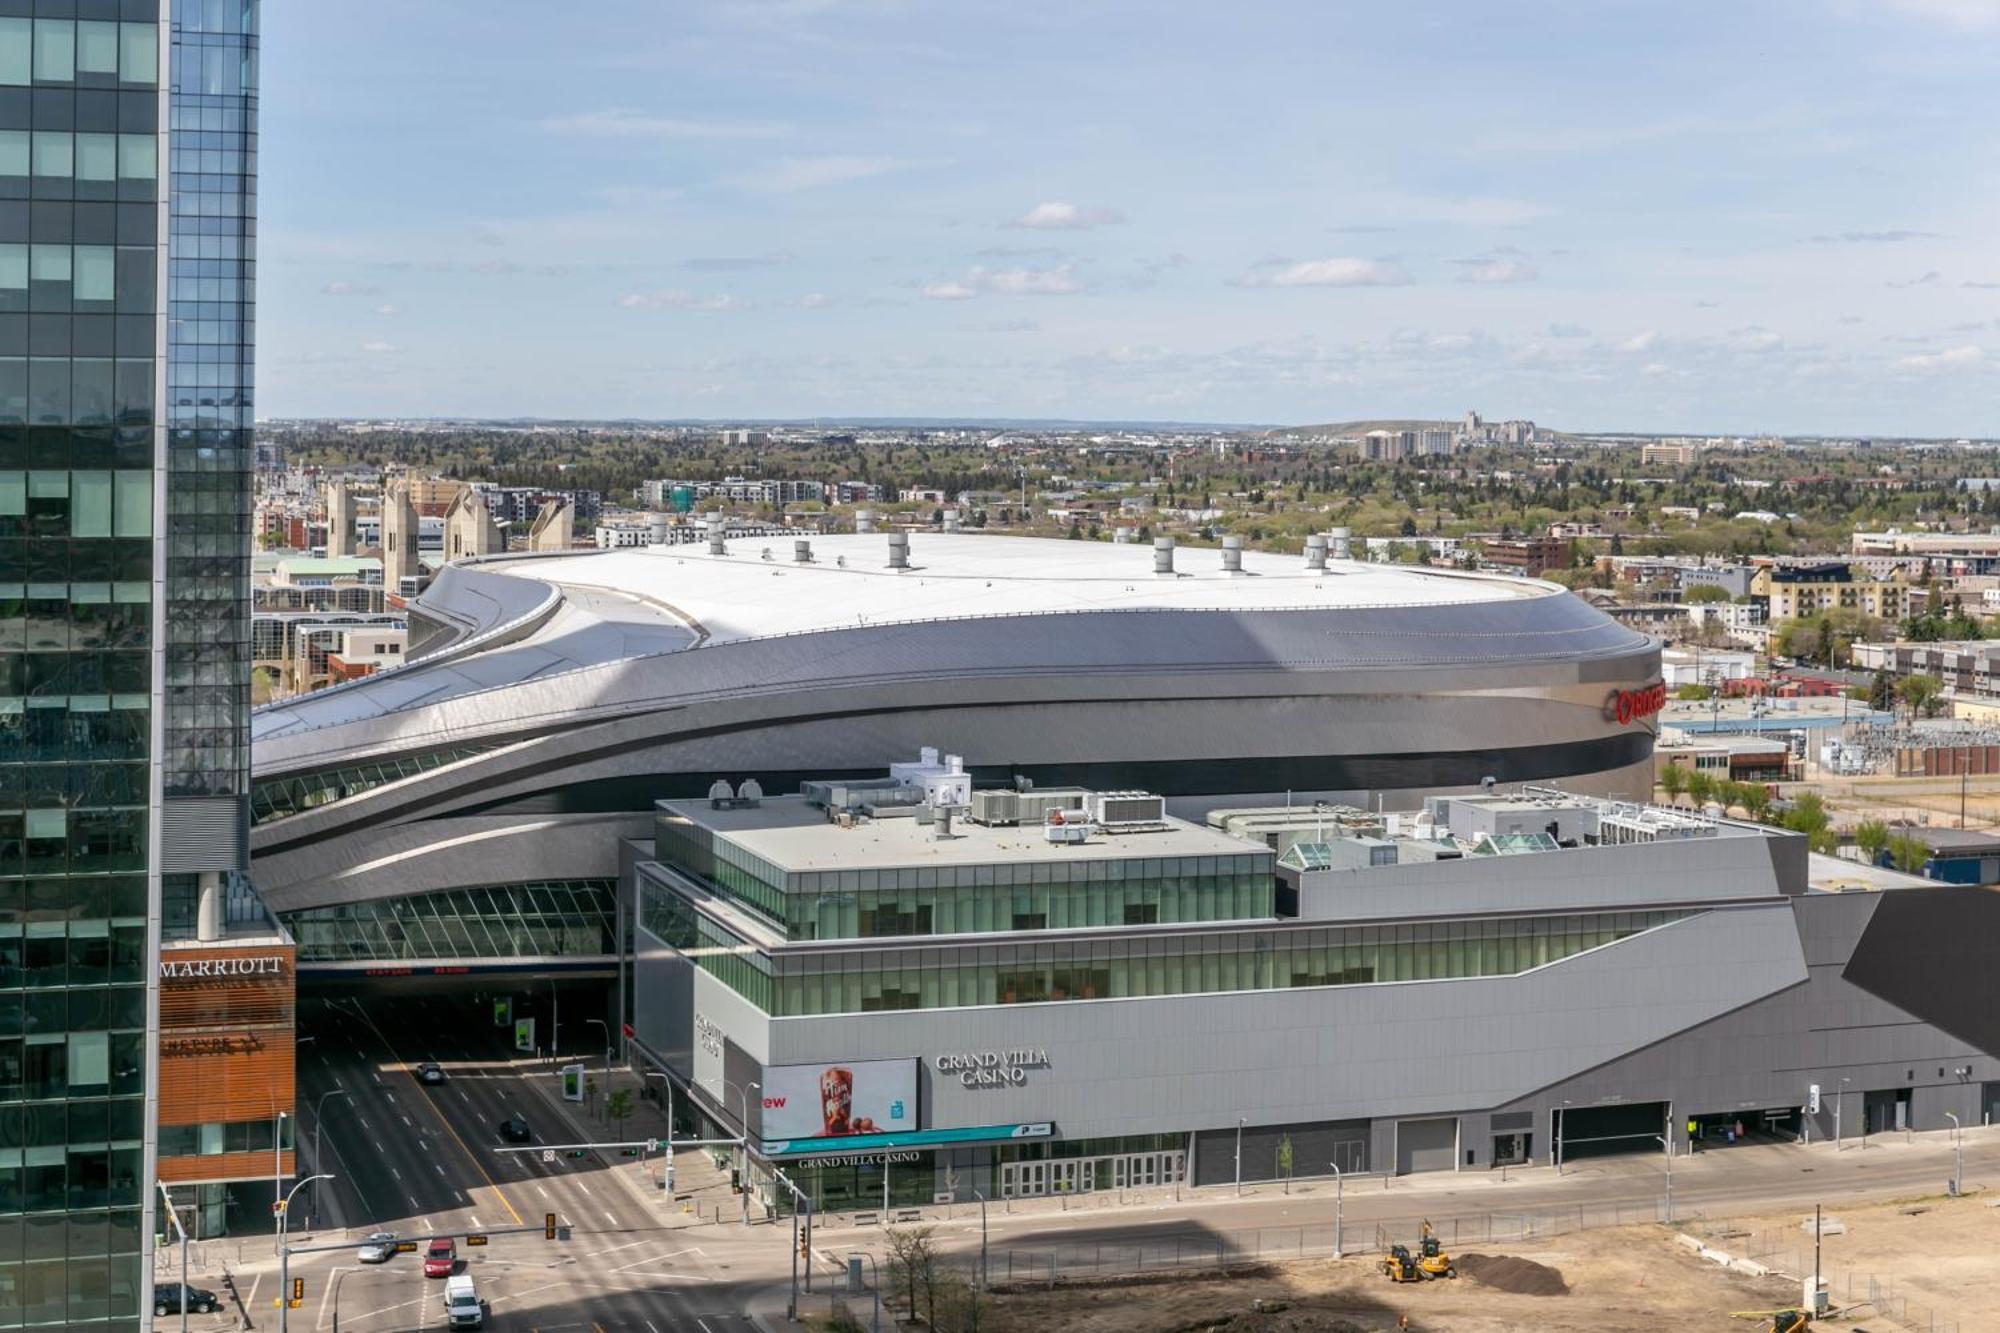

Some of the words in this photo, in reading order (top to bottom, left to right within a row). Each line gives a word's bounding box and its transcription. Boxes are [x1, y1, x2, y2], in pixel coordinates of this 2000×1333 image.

[159, 957, 283, 977] MARRIOTT
[936, 1052, 997, 1070] GRAND
[1001, 1049, 1049, 1066] VILLA
[960, 1067, 1025, 1085] CASINO
[799, 1156, 840, 1169] GRAND
[841, 1154, 874, 1167] VILLA
[876, 1151, 920, 1164] CASINO
